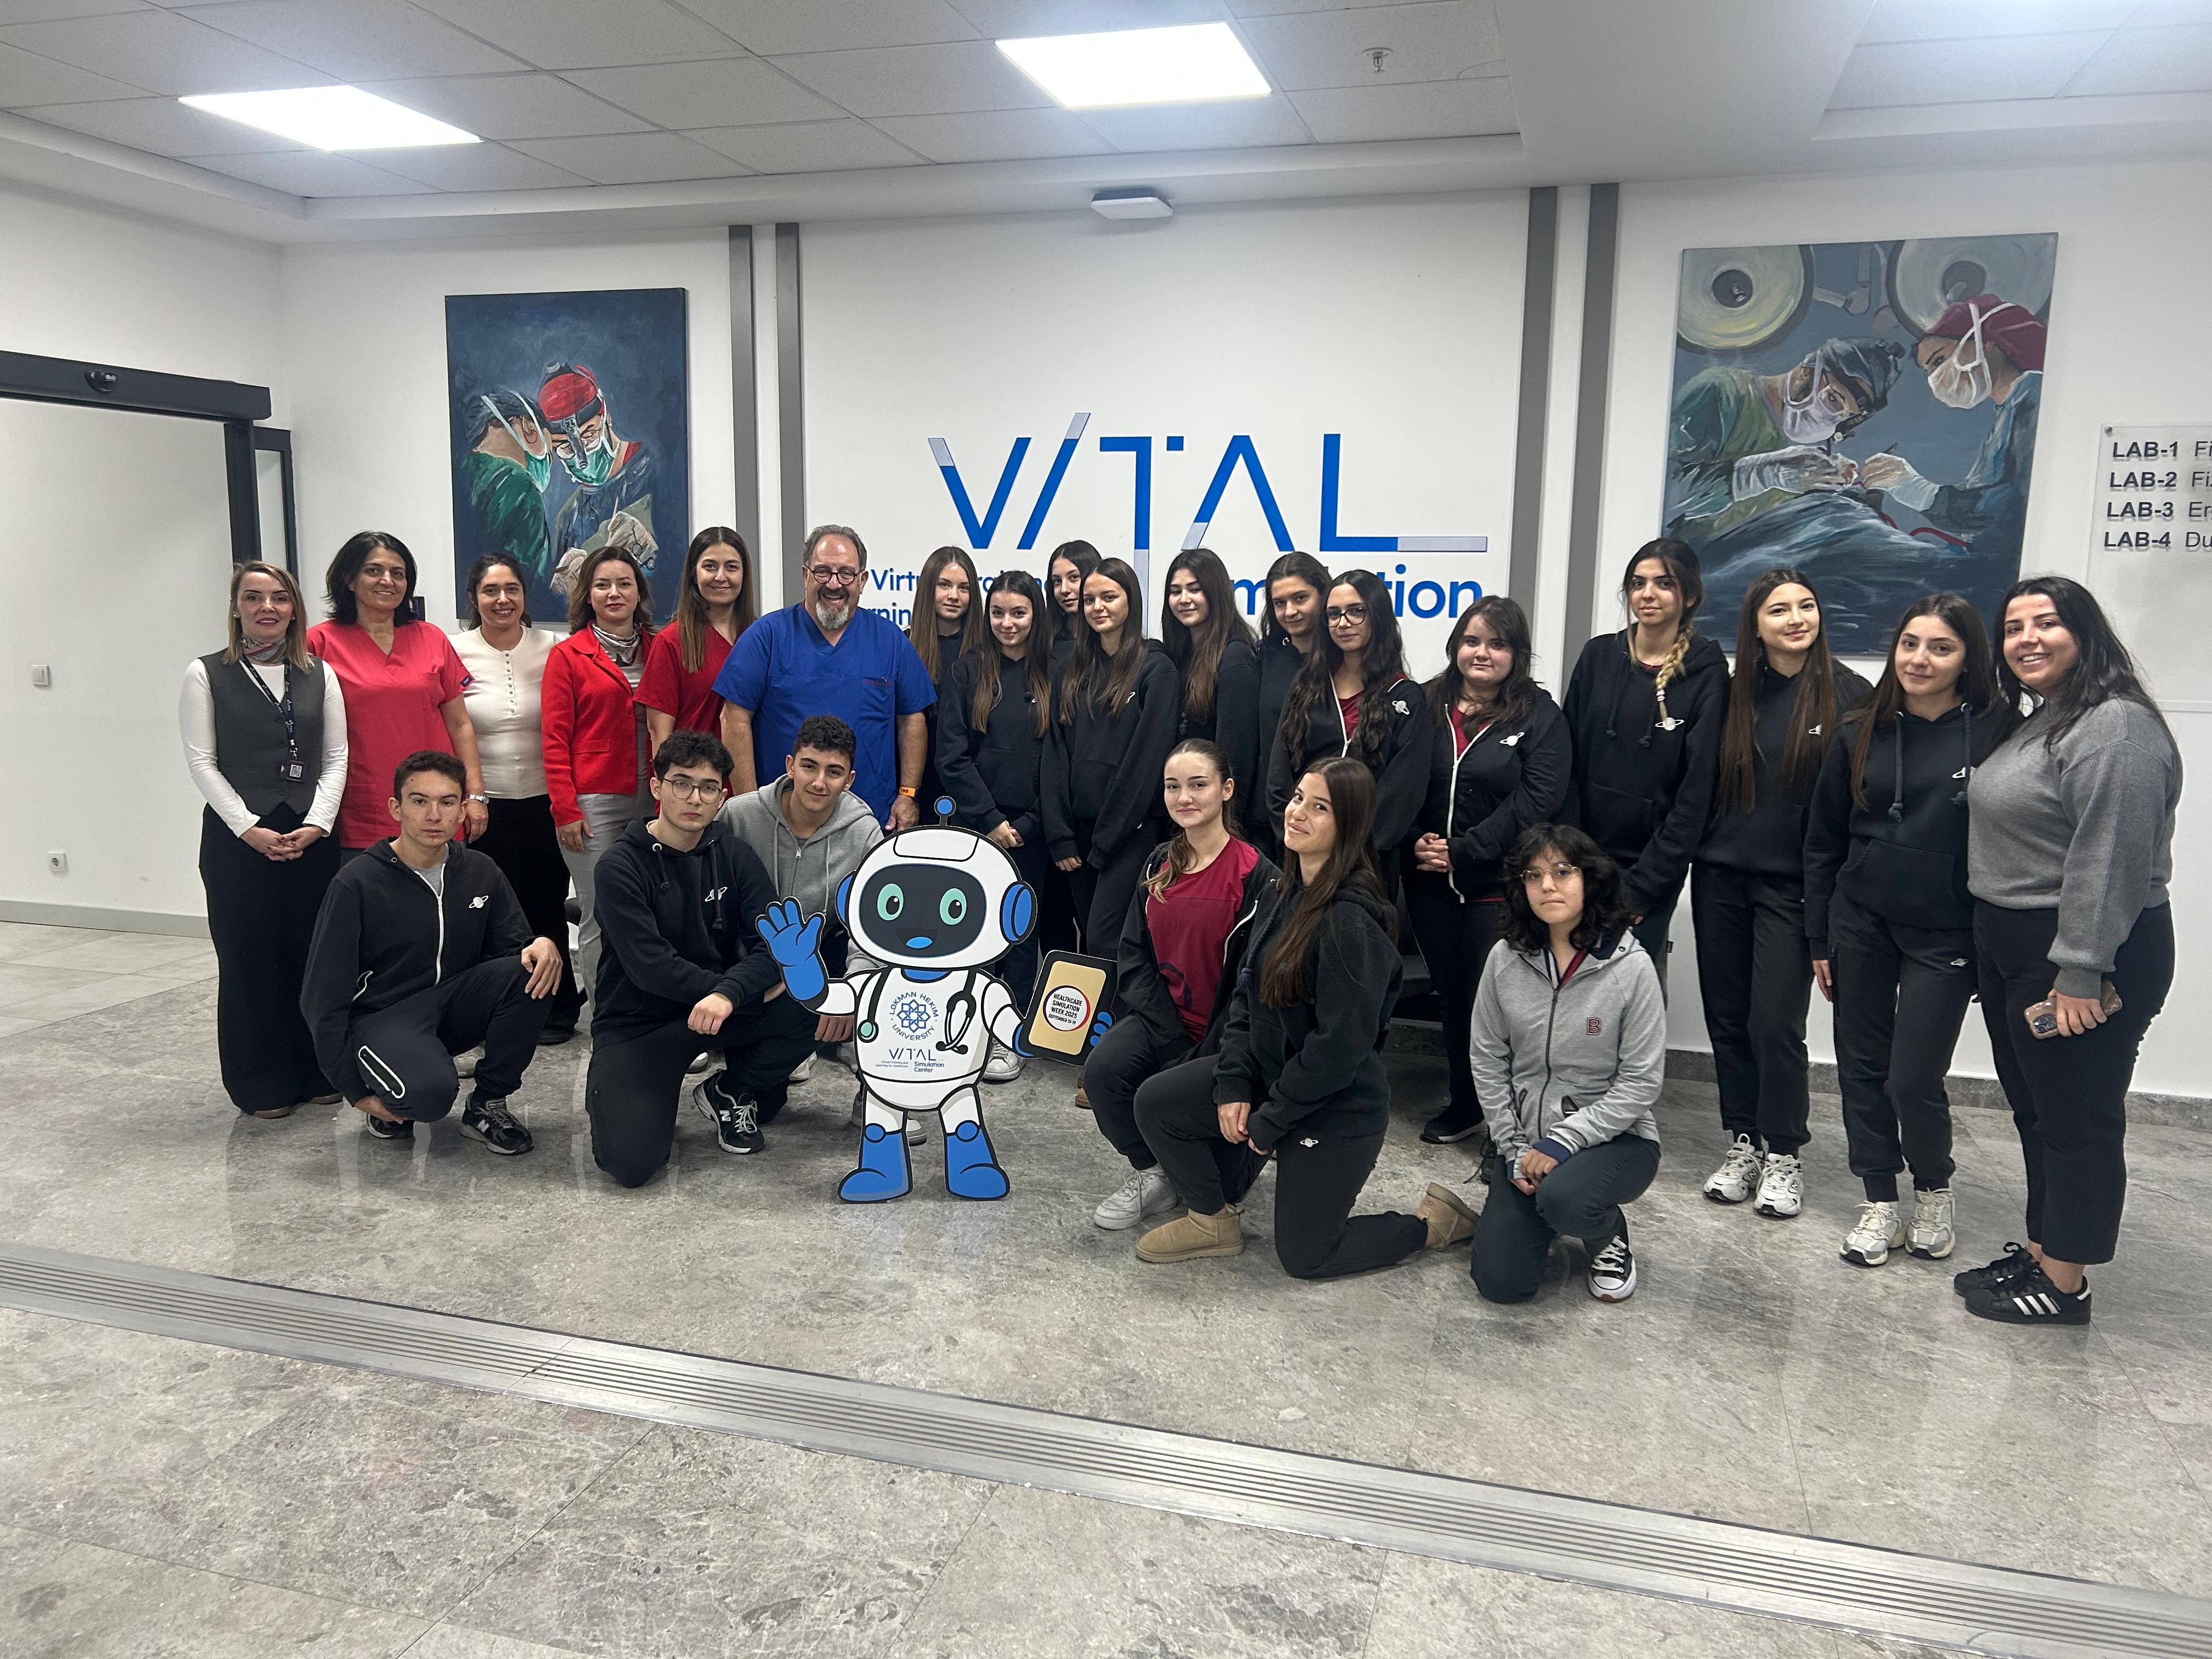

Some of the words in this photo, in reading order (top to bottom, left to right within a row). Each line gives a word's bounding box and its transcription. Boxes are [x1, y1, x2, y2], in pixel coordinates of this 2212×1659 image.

[2113, 441, 2178, 458] LAB-1
[928, 413, 1488, 553] VITAL
[2110, 471, 2177, 488] LAB-2
[2192, 471, 2212, 487] Fi
[2107, 501, 2174, 518] LAB-3
[2188, 501, 2212, 519] Er
[2104, 531, 2171, 548] LAB-4
[871, 568, 920, 591] Virt
[889, 992, 916, 1015] LOKMAN
[919, 993, 939, 1017] HEKIM
[1052, 1000, 1080, 1012] SIMULATION
[1053, 994, 1083, 1006] HEALTHCARE
[1052, 1007, 1064, 1015] WEEK
[1064, 1010, 1078, 1019] 2025
[893, 1024, 934, 1041] UNIVERSITY
[1587, 1017, 1601, 1035] B
[888, 1047, 936, 1061] VITAL
